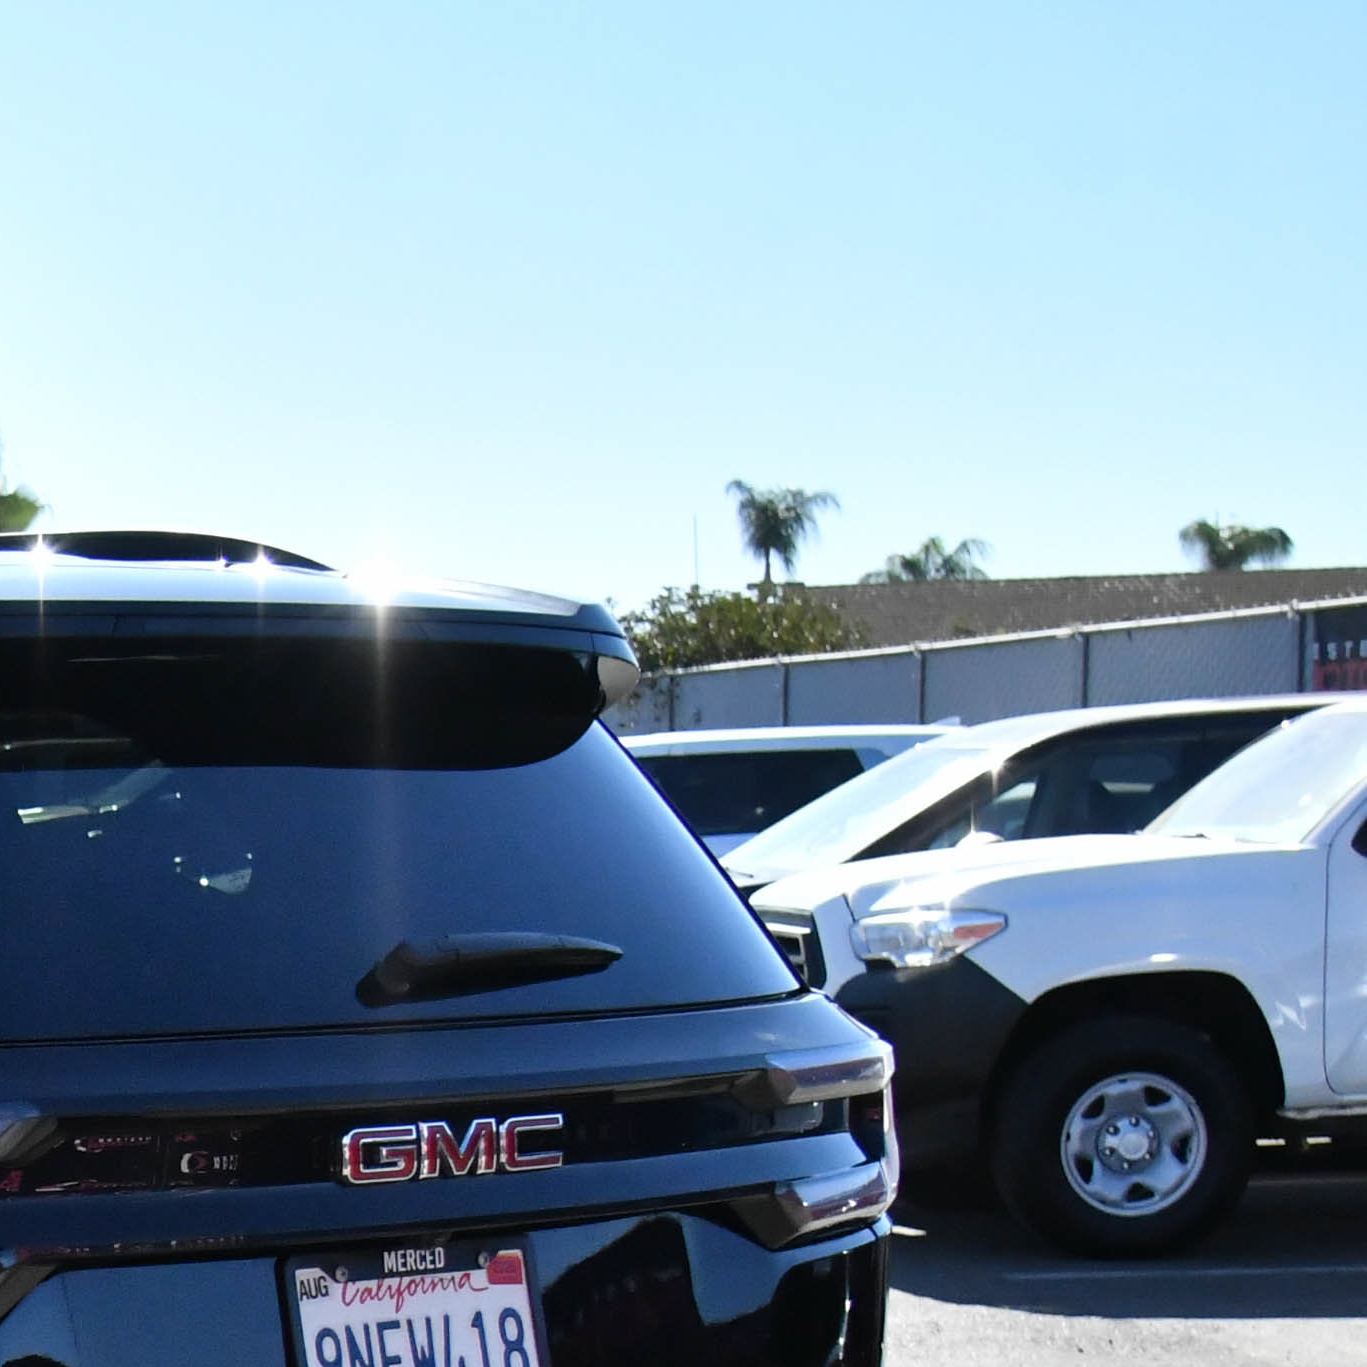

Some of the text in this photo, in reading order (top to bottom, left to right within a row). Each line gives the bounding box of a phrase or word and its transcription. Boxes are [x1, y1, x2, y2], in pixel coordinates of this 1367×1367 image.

[342, 1113, 564, 1184] GMC
[383, 1247, 445, 1273] MERCED
[298, 1275, 329, 1301] AUG
[341, 1272, 489, 1313] California
